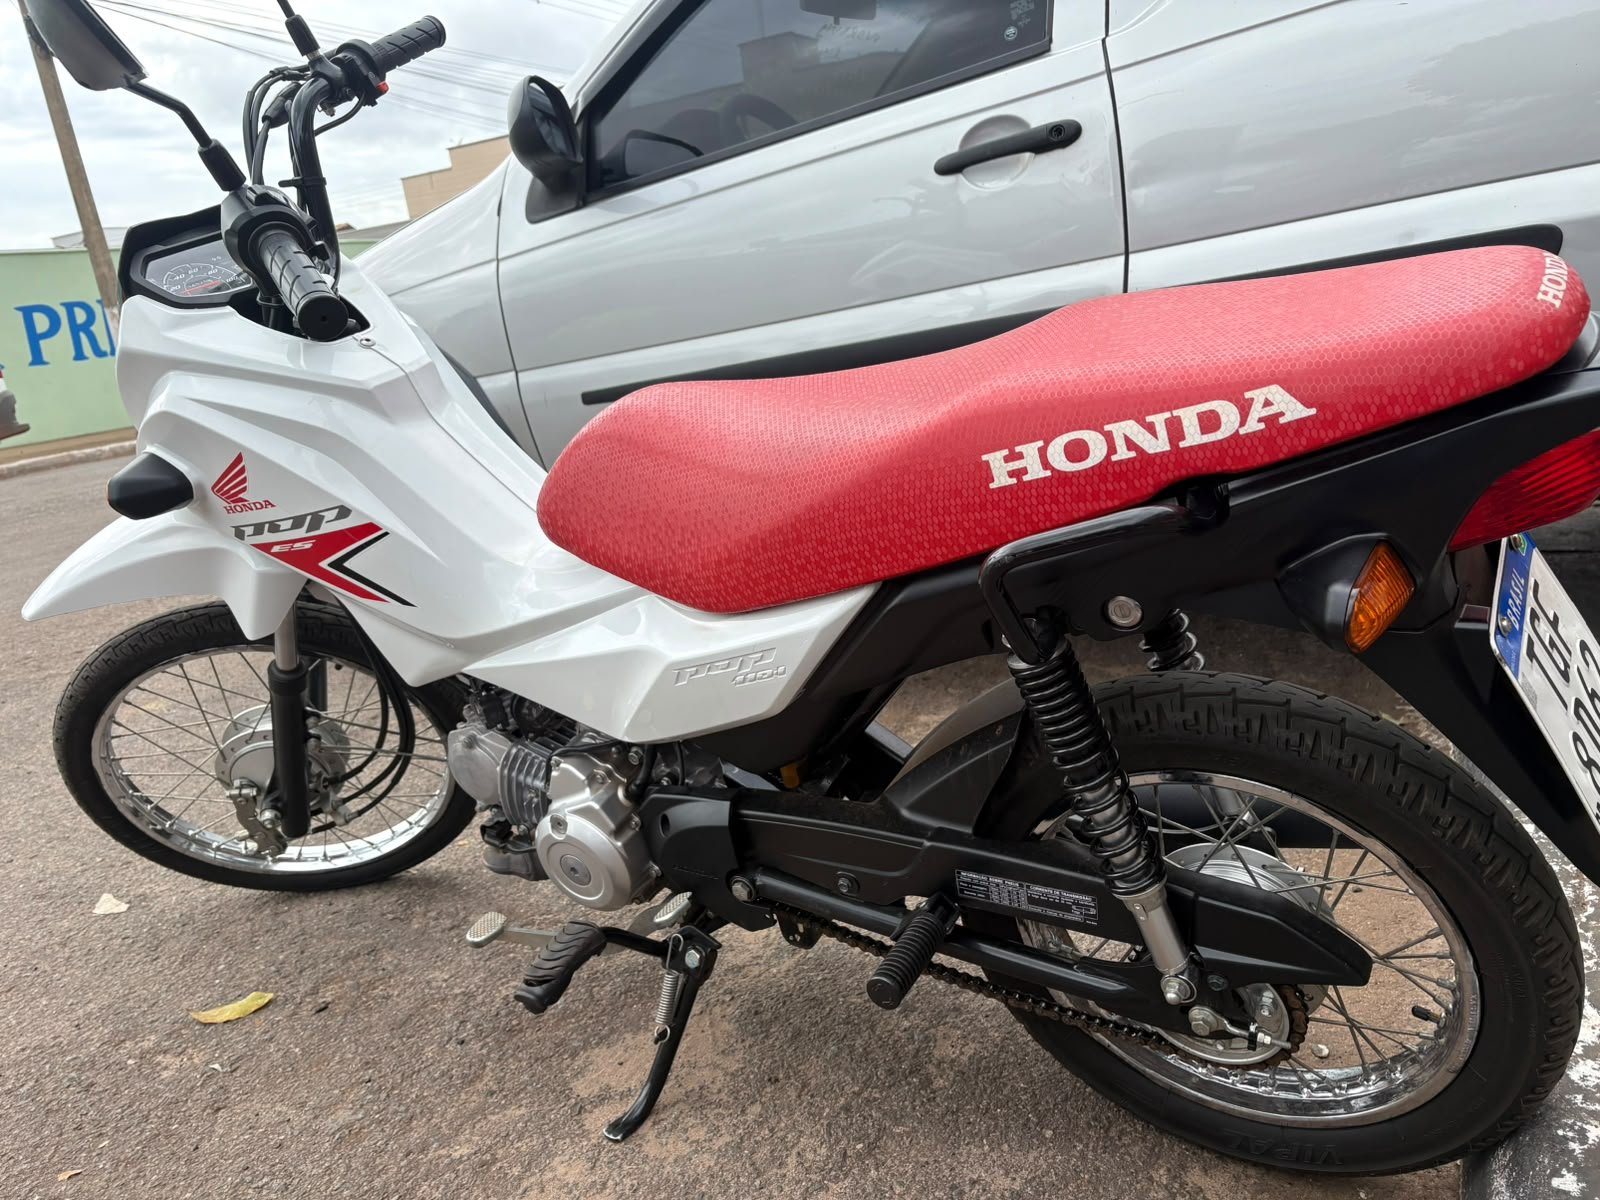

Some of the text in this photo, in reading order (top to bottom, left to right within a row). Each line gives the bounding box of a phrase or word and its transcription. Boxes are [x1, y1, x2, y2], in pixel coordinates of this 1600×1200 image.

[981, 384, 1317, 489] HONDA
[223, 499, 276, 515] HONDA
[270, 539, 317, 553] ES
[1506, 567, 1525, 632] BRASIL
[1523, 577, 1574, 713] TGF
